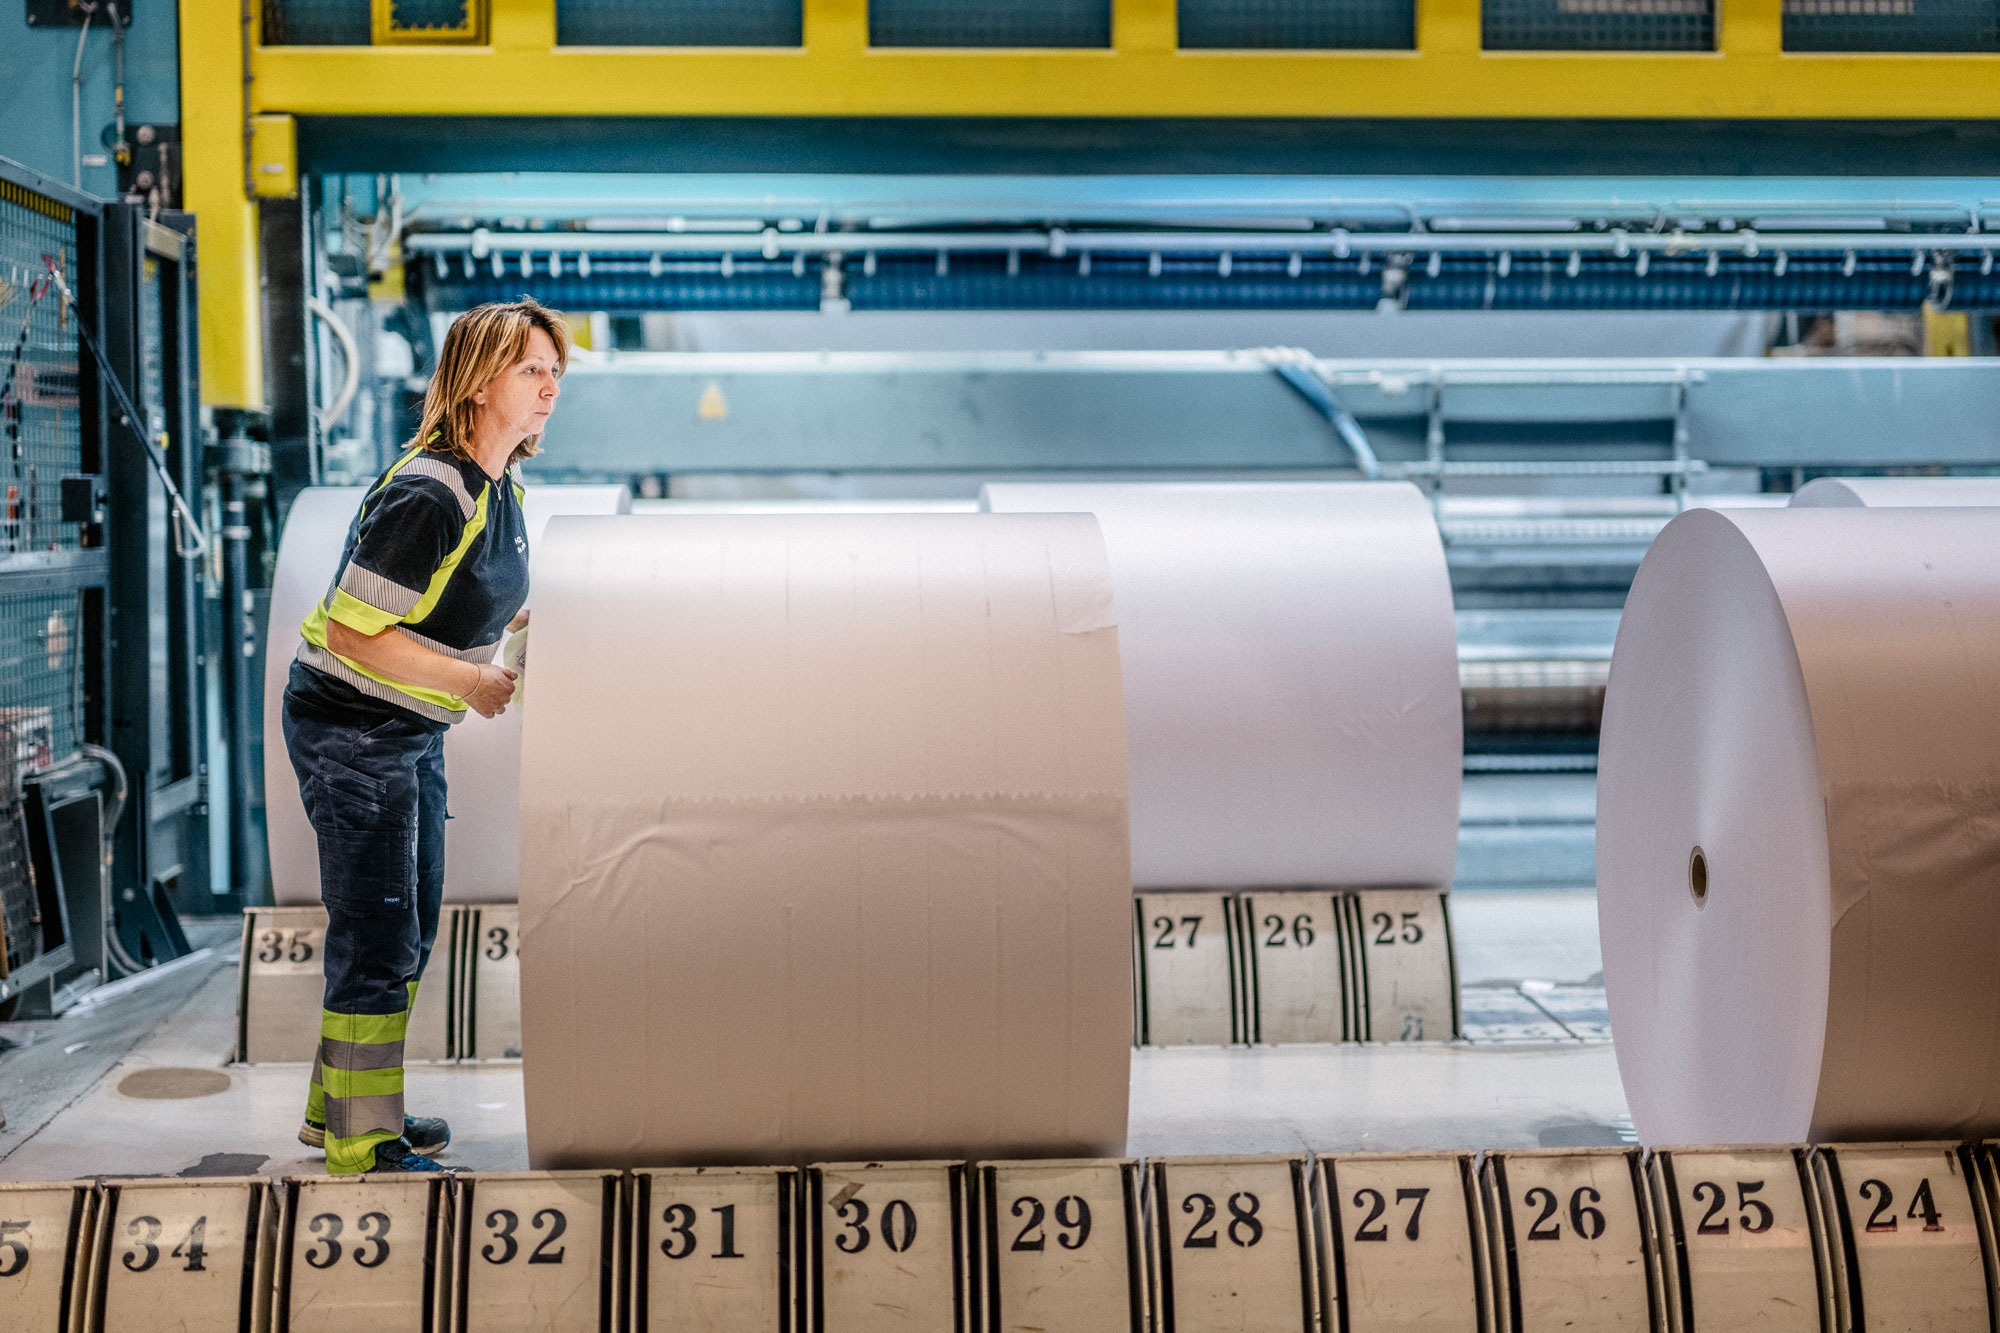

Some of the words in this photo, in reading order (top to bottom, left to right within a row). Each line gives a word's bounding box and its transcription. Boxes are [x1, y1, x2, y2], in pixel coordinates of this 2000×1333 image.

[259, 930, 313, 963] 35
[487, 927, 520, 961] 3
[1153, 916, 1203, 949] 27
[1264, 914, 1314, 947] 26
[1372, 912, 1423, 945] 25
[661, 1203, 745, 1260] 31
[835, 1198, 917, 1254] 30
[1011, 1195, 1092, 1252] 29
[1182, 1192, 1264, 1249] 28
[1353, 1187, 1430, 1242] 27
[1525, 1186, 1606, 1241] 26
[1693, 1180, 1774, 1235] 25
[1859, 1178, 1944, 1233] 24
[122, 1215, 208, 1273] 34
[305, 1211, 390, 1269] 33
[482, 1208, 566, 1265] 32
